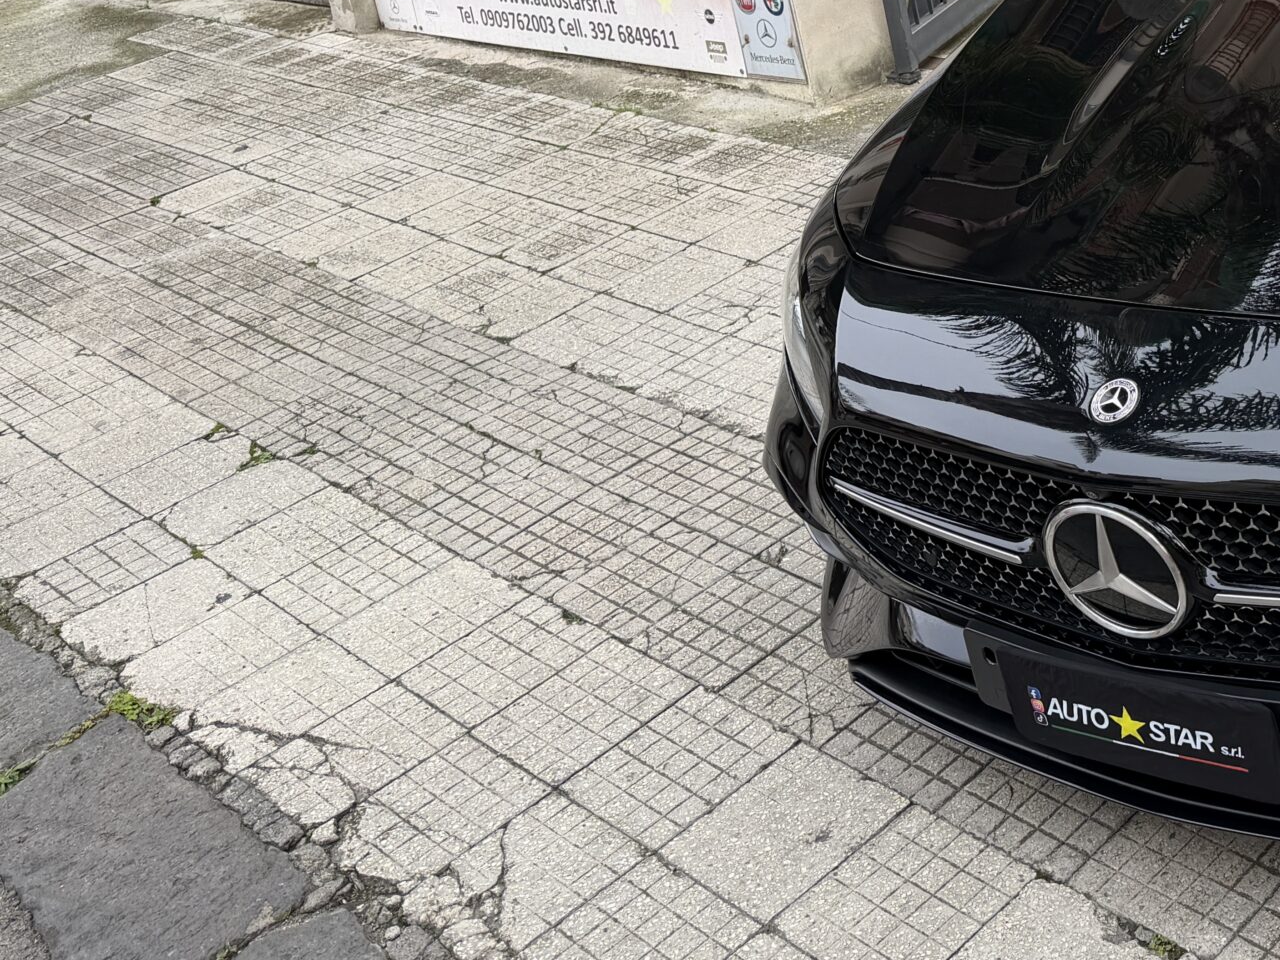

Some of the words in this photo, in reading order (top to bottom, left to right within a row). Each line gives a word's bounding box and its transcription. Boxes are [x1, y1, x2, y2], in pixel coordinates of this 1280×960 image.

[457, 6, 478, 25] Tel.
[480, 9, 556, 34] 0909762003
[558, 17, 588, 39] Cell.
[589, 21, 615, 42] 392
[617, 25, 679, 50] 6849611
[750, 52, 796, 66] Mercedes-Benz
[1047, 697, 1110, 730] AUTO
[1149, 720, 1215, 753] STAR
